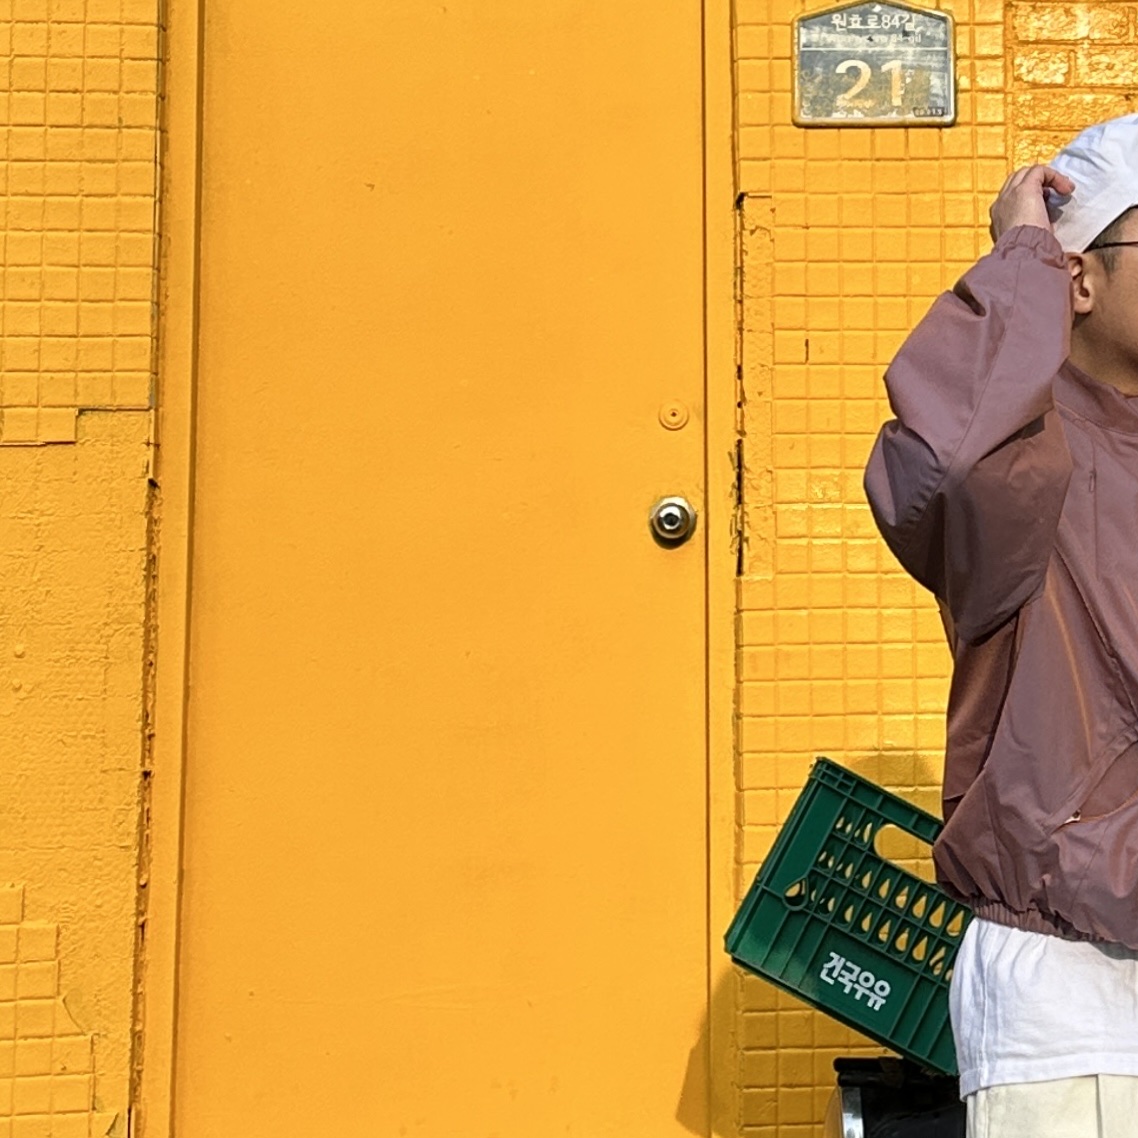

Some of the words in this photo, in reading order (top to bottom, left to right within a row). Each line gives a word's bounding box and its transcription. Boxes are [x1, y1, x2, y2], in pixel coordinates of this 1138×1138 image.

[830, 12, 916, 32] 원효로84길
[835, 59, 903, 108] 21
[820, 951, 891, 1011] 건국우유
